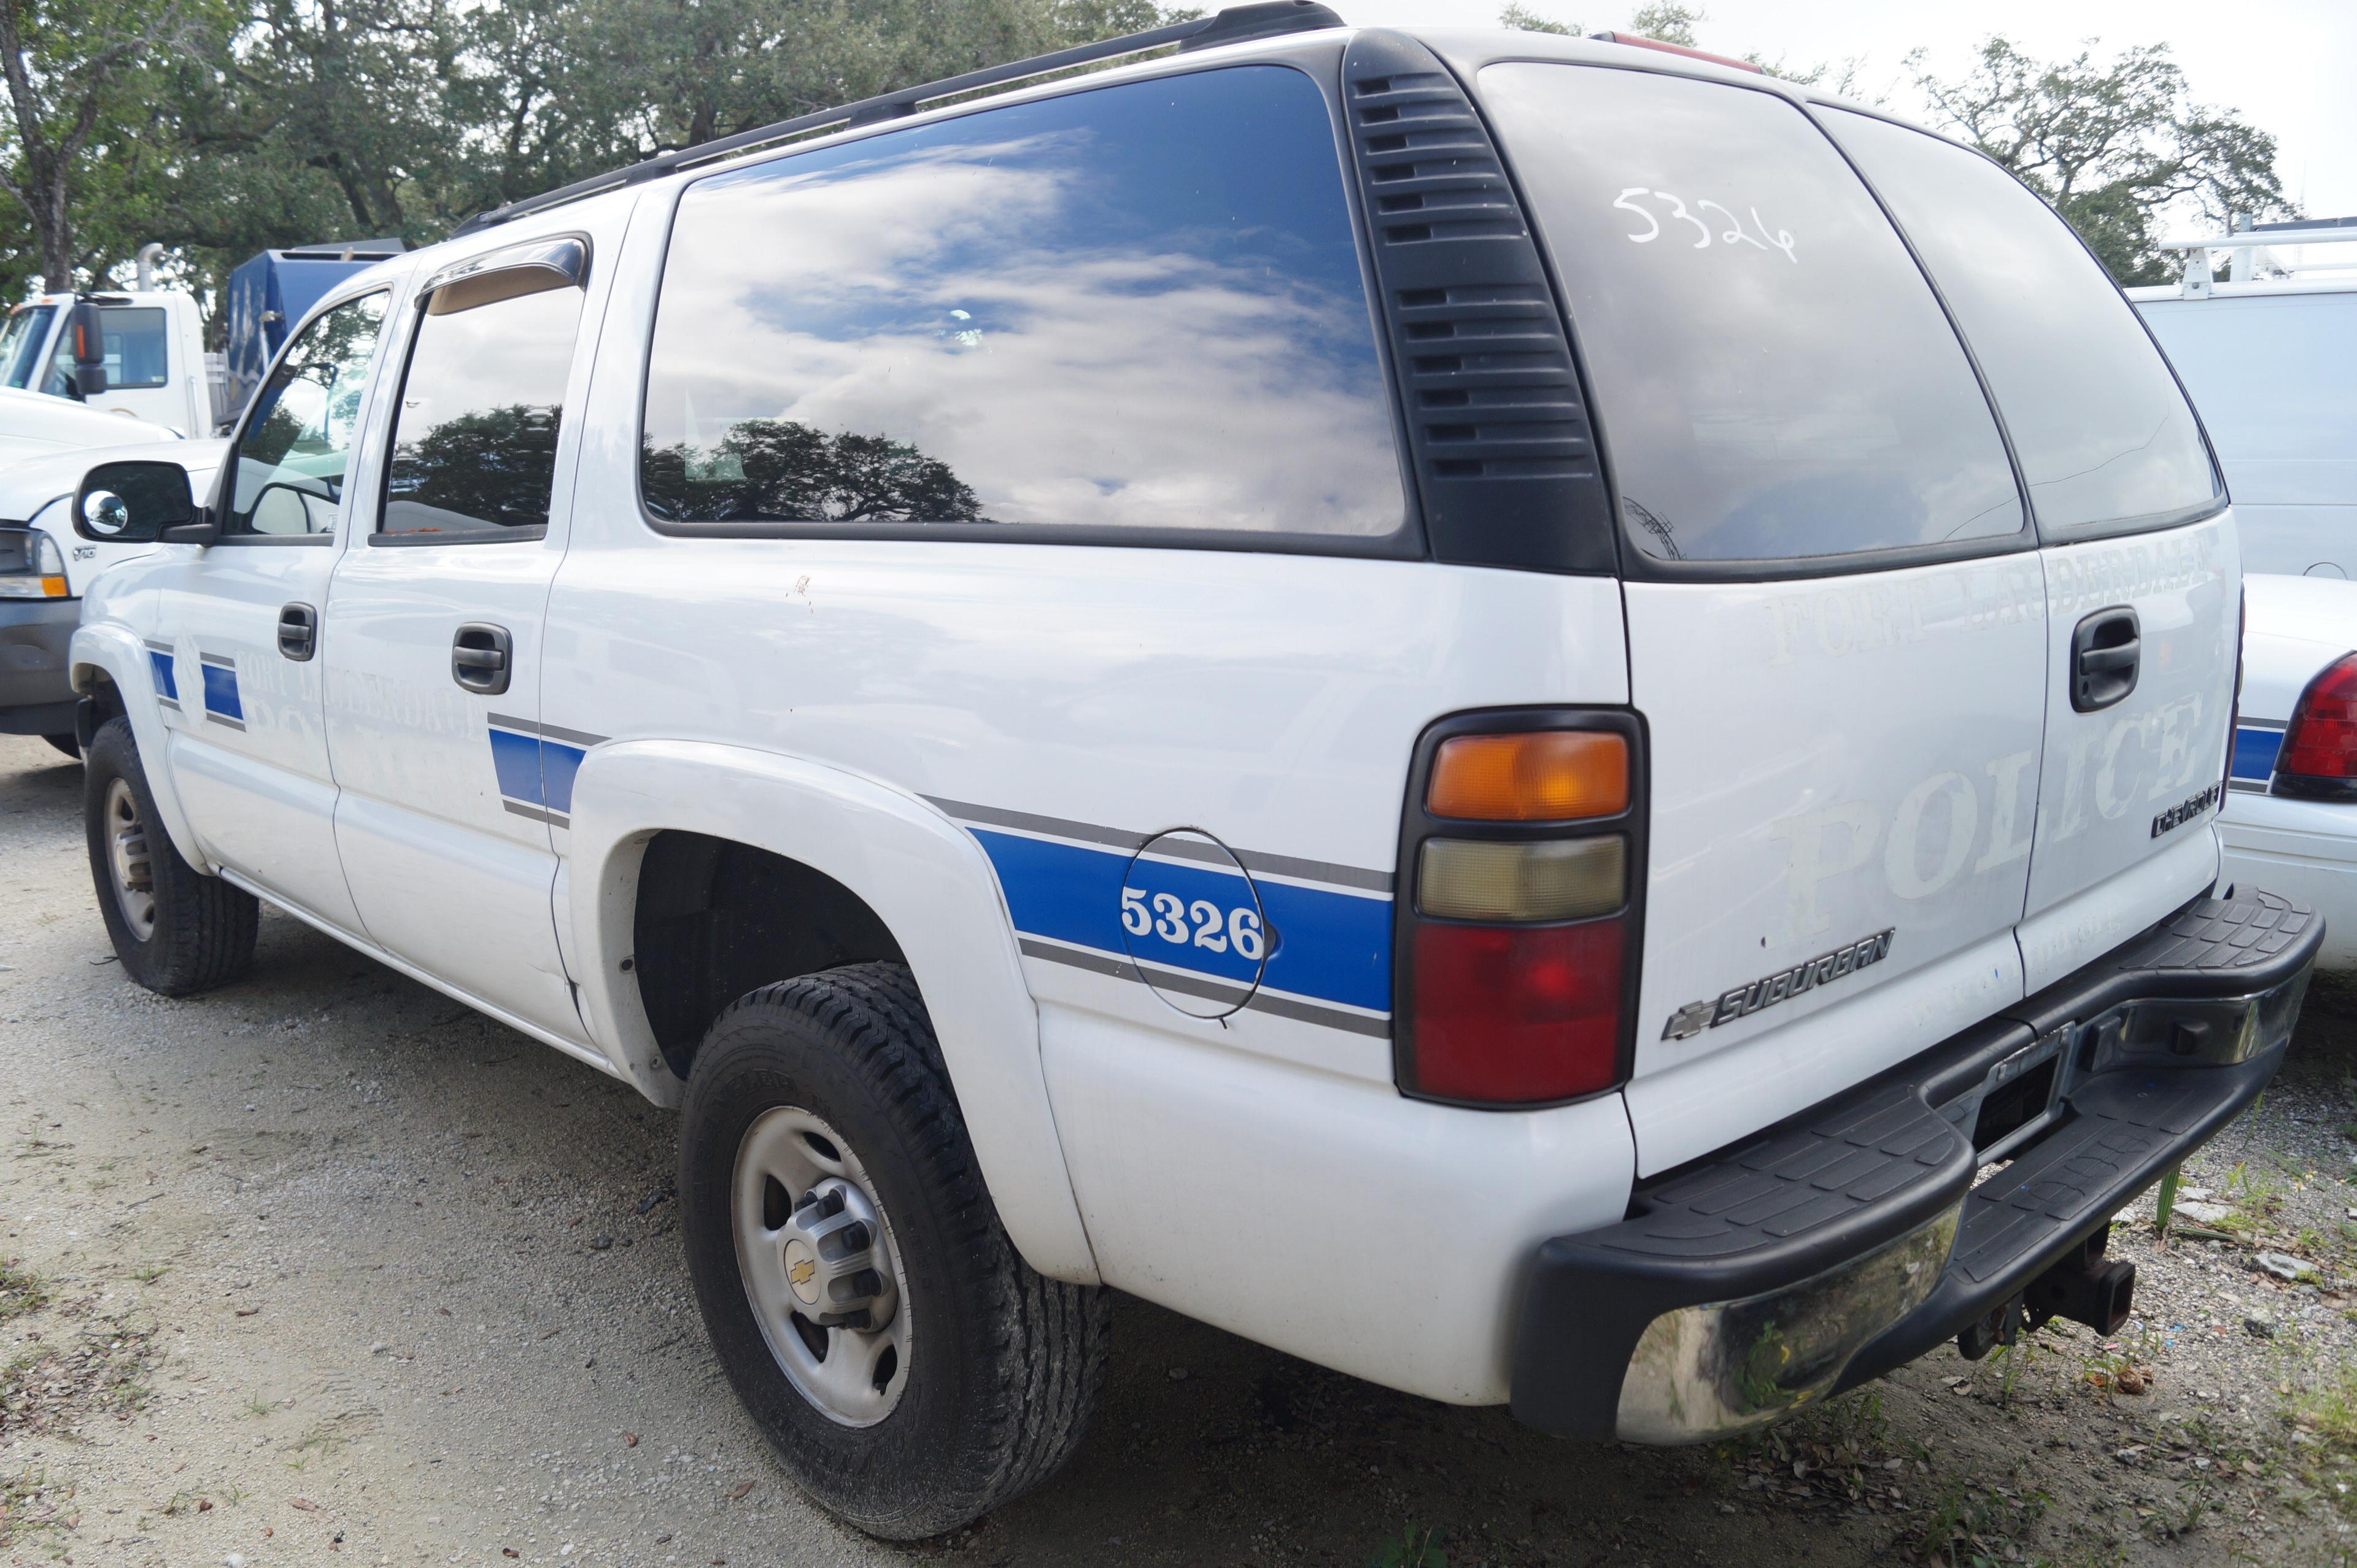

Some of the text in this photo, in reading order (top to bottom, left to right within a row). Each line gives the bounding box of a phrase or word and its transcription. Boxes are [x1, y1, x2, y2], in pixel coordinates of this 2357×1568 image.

[1612, 187, 1798, 265] 5326
[1765, 536, 2208, 668] FORT LAUDERDALE
[1764, 692, 2202, 951] POLICE
[1121, 886, 1264, 960] 5326
[1710, 925, 1895, 1028] SUBURBAN
